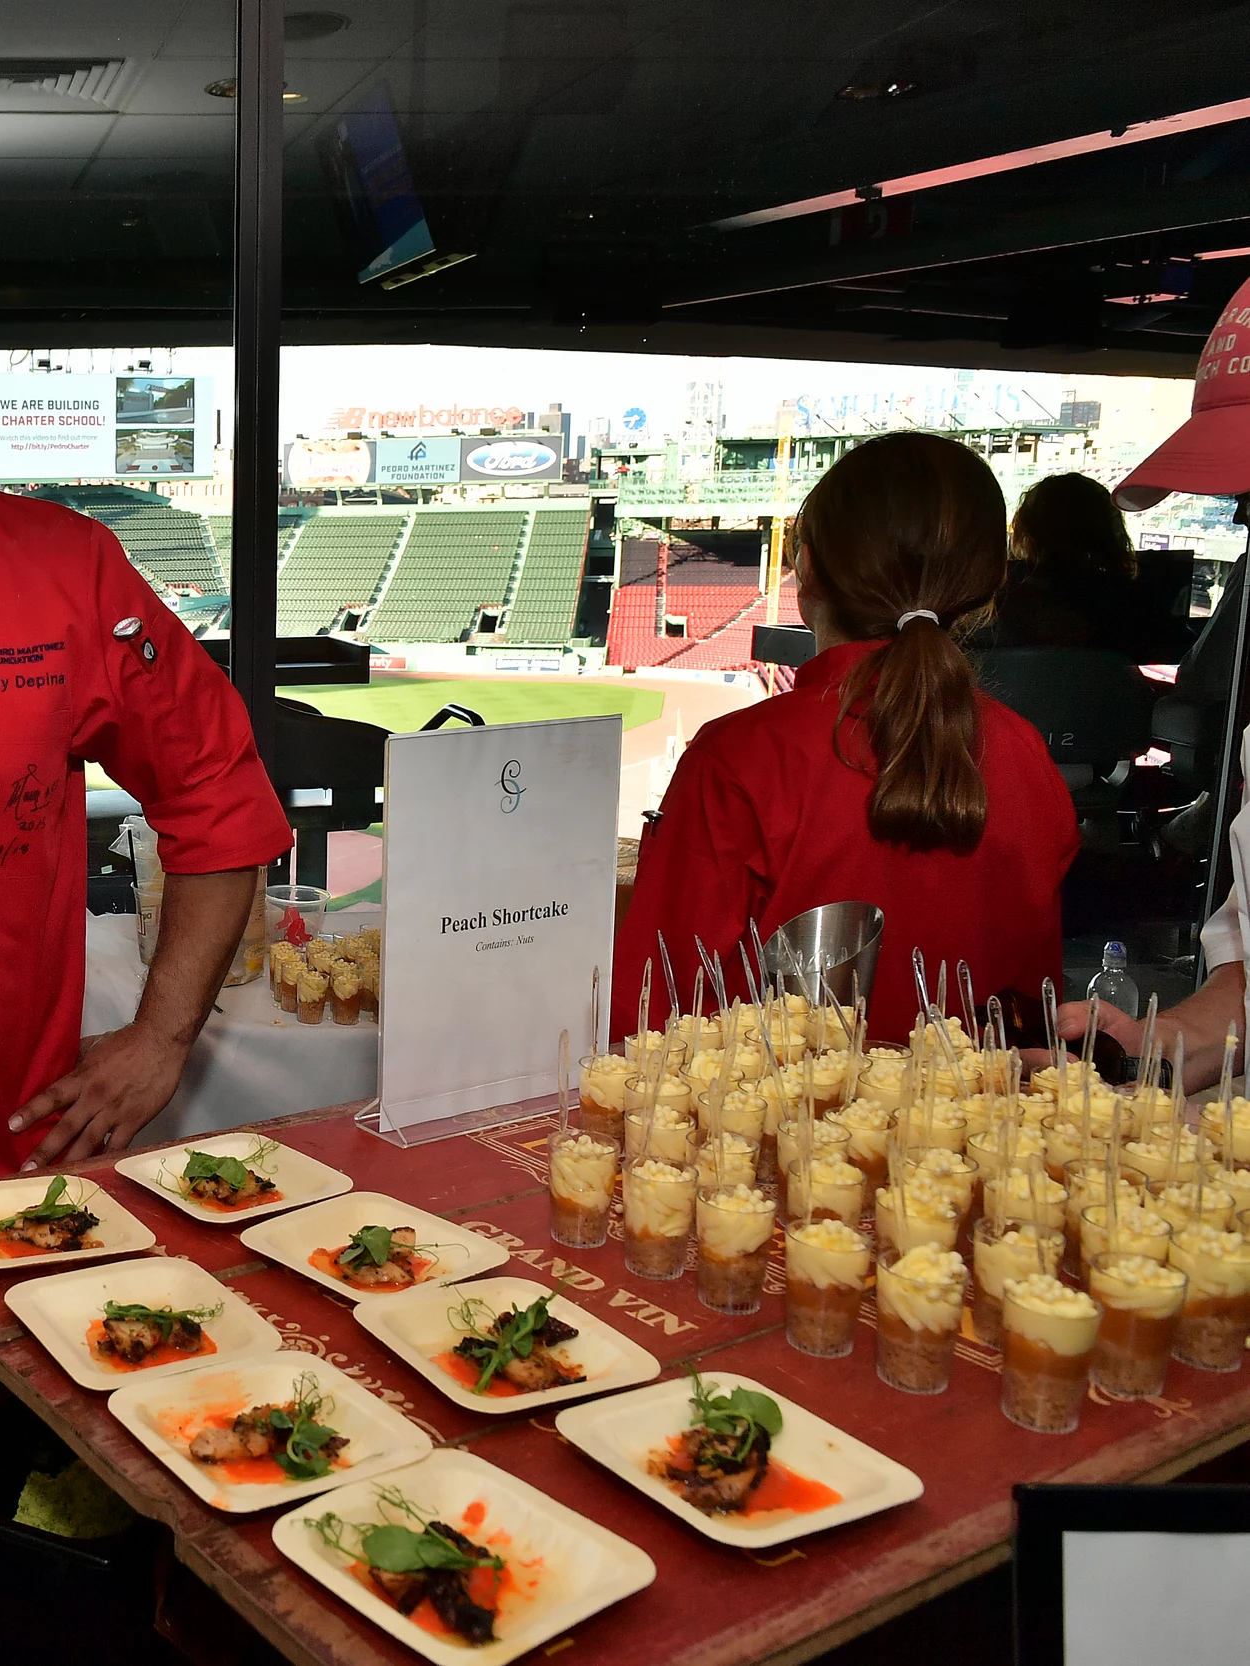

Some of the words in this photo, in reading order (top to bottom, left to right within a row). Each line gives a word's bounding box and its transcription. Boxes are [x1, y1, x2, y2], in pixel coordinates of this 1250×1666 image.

[0, 399, 18, 410] WE
[22, 399, 44, 410] ARE
[48, 399, 100, 410] BUILDING
[2, 415, 55, 426] CHARTER
[58, 415, 106, 426] SCHOOL!
[368, 409, 417, 429] new
[419, 403, 523, 428] balance
[0, 434, 18, 442] Watch
[19, 434, 31, 442] this
[32, 434, 49, 442] video
[50, 434, 57, 442] to
[57, 433, 69, 441] find
[381, 464, 410, 473] PEDRO
[411, 463, 456, 473] MARTINEZ
[483, 451, 539, 470] Ford
[390, 472, 445, 481] FOUNDATION
[15, 671, 66, 689] Depina
[440, 911, 488, 935] Peach
[492, 900, 569, 926] Shortcake
[475, 939, 514, 952] Contains:
[516, 935, 535, 946] Nuts
[461, 1221, 605, 1292] GRAND
[608, 1288, 699, 1336] VIN
